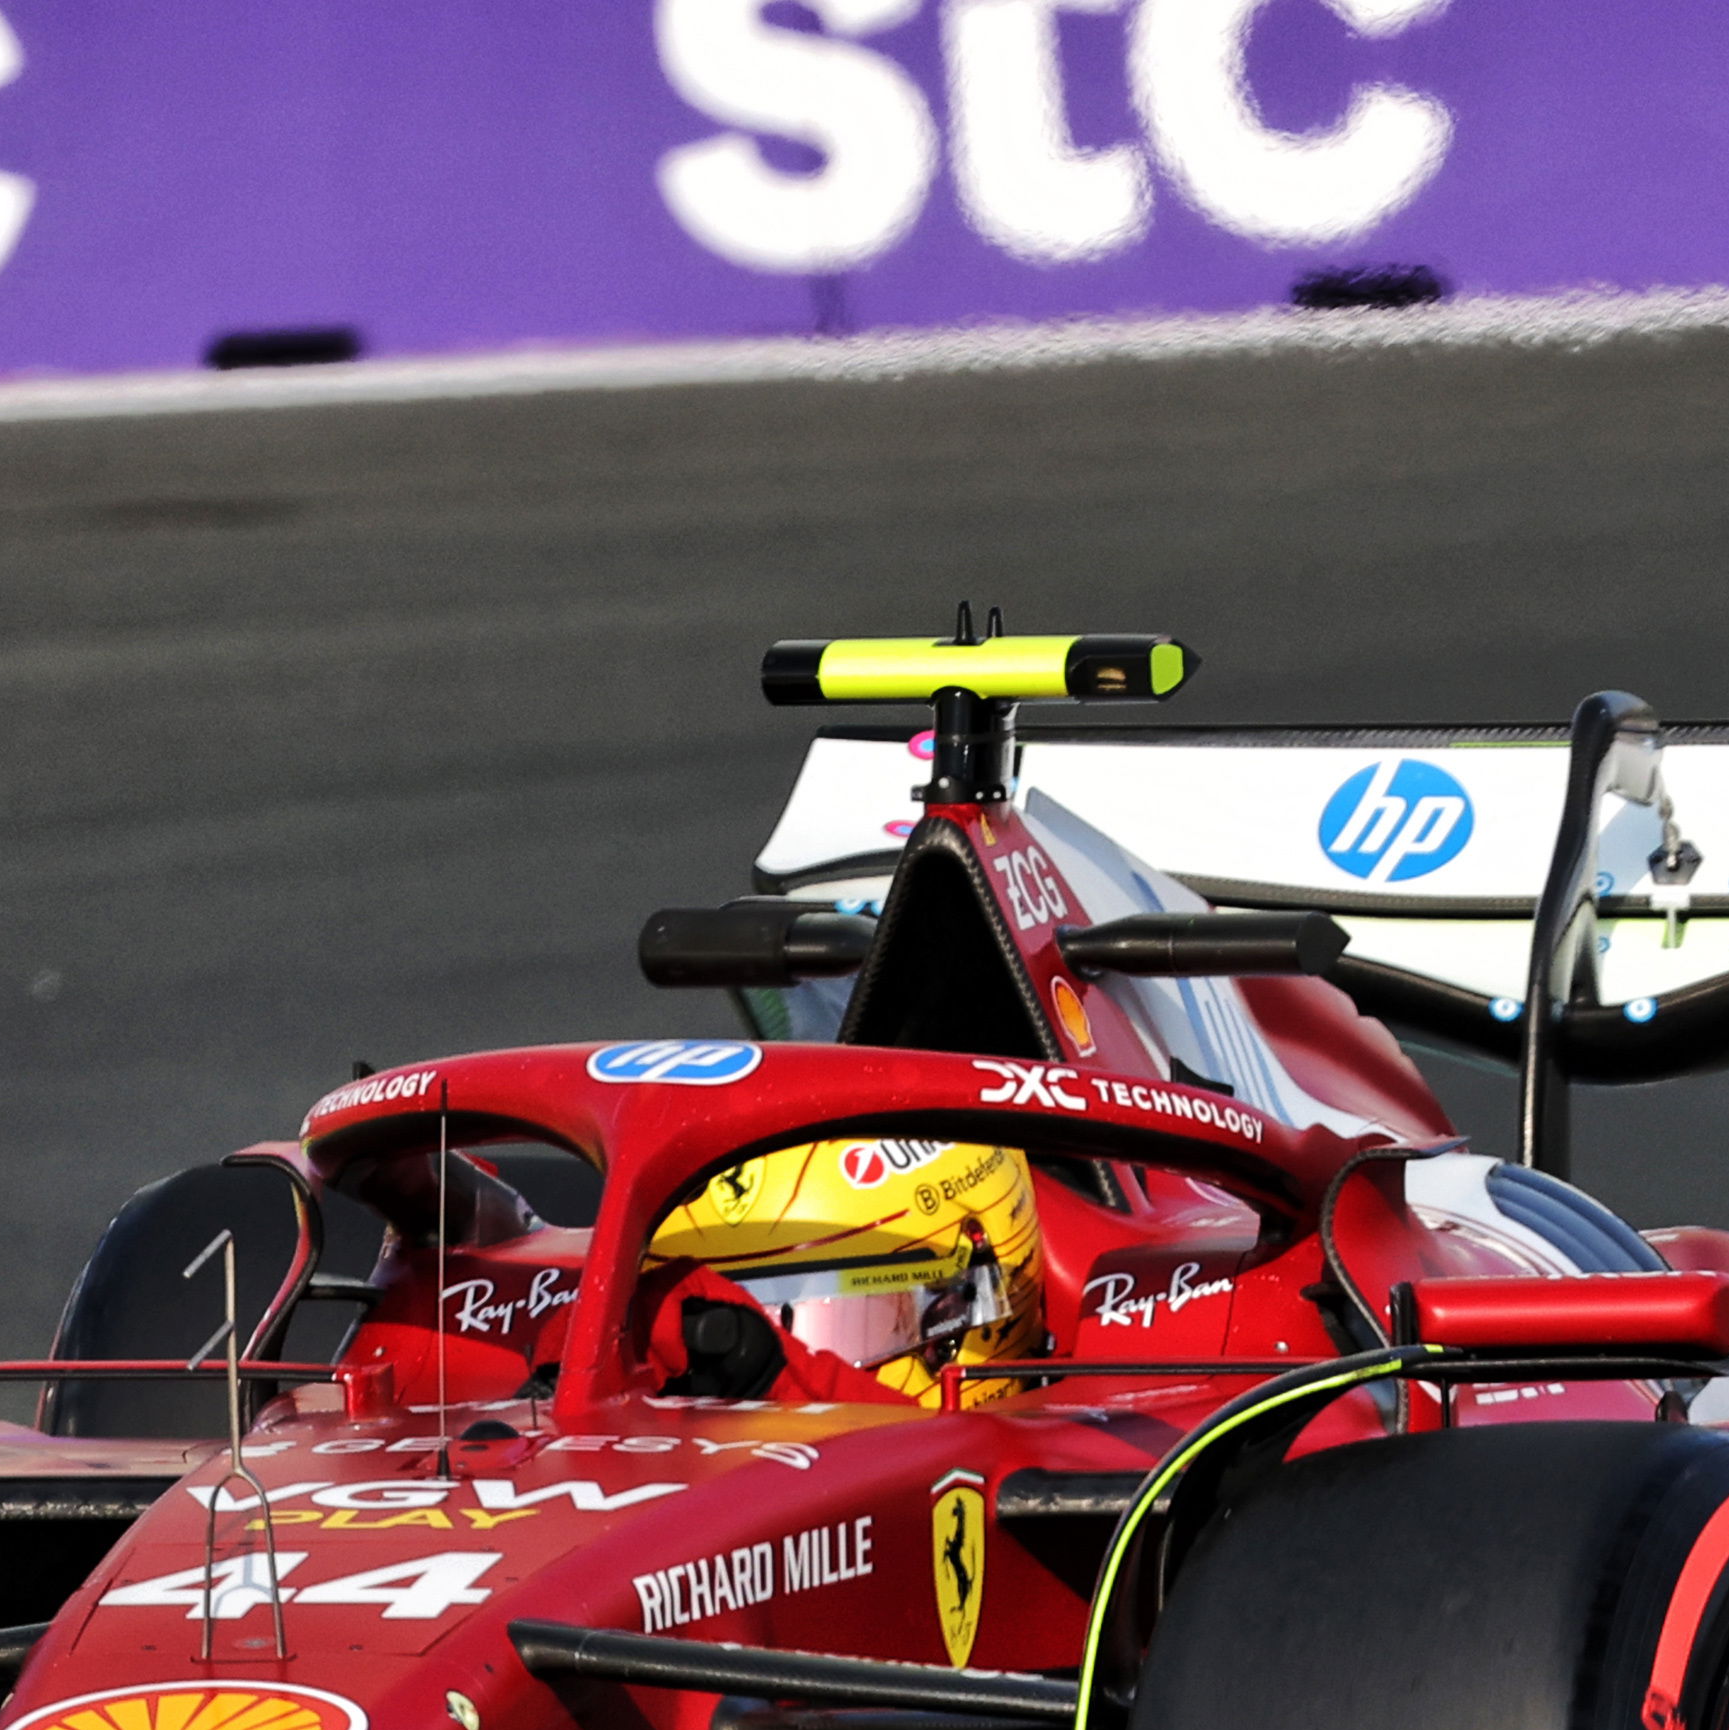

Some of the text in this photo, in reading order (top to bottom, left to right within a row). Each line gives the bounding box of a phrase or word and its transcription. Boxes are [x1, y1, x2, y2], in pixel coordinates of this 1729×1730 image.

[1327, 759, 1468, 882] hp
[604, 1039, 746, 1081] hp
[972, 1060, 1264, 1144] DXC TECHNOLOGY
[1083, 1262, 1234, 1328] Ray-Ban
[310, 1433, 820, 1471] GEESYS
[184, 1479, 689, 1512] VGW
[248, 1508, 539, 1530] PLAY
[99, 1550, 504, 1620] 44
[633, 1515, 874, 1634] RICHARD MILLE
